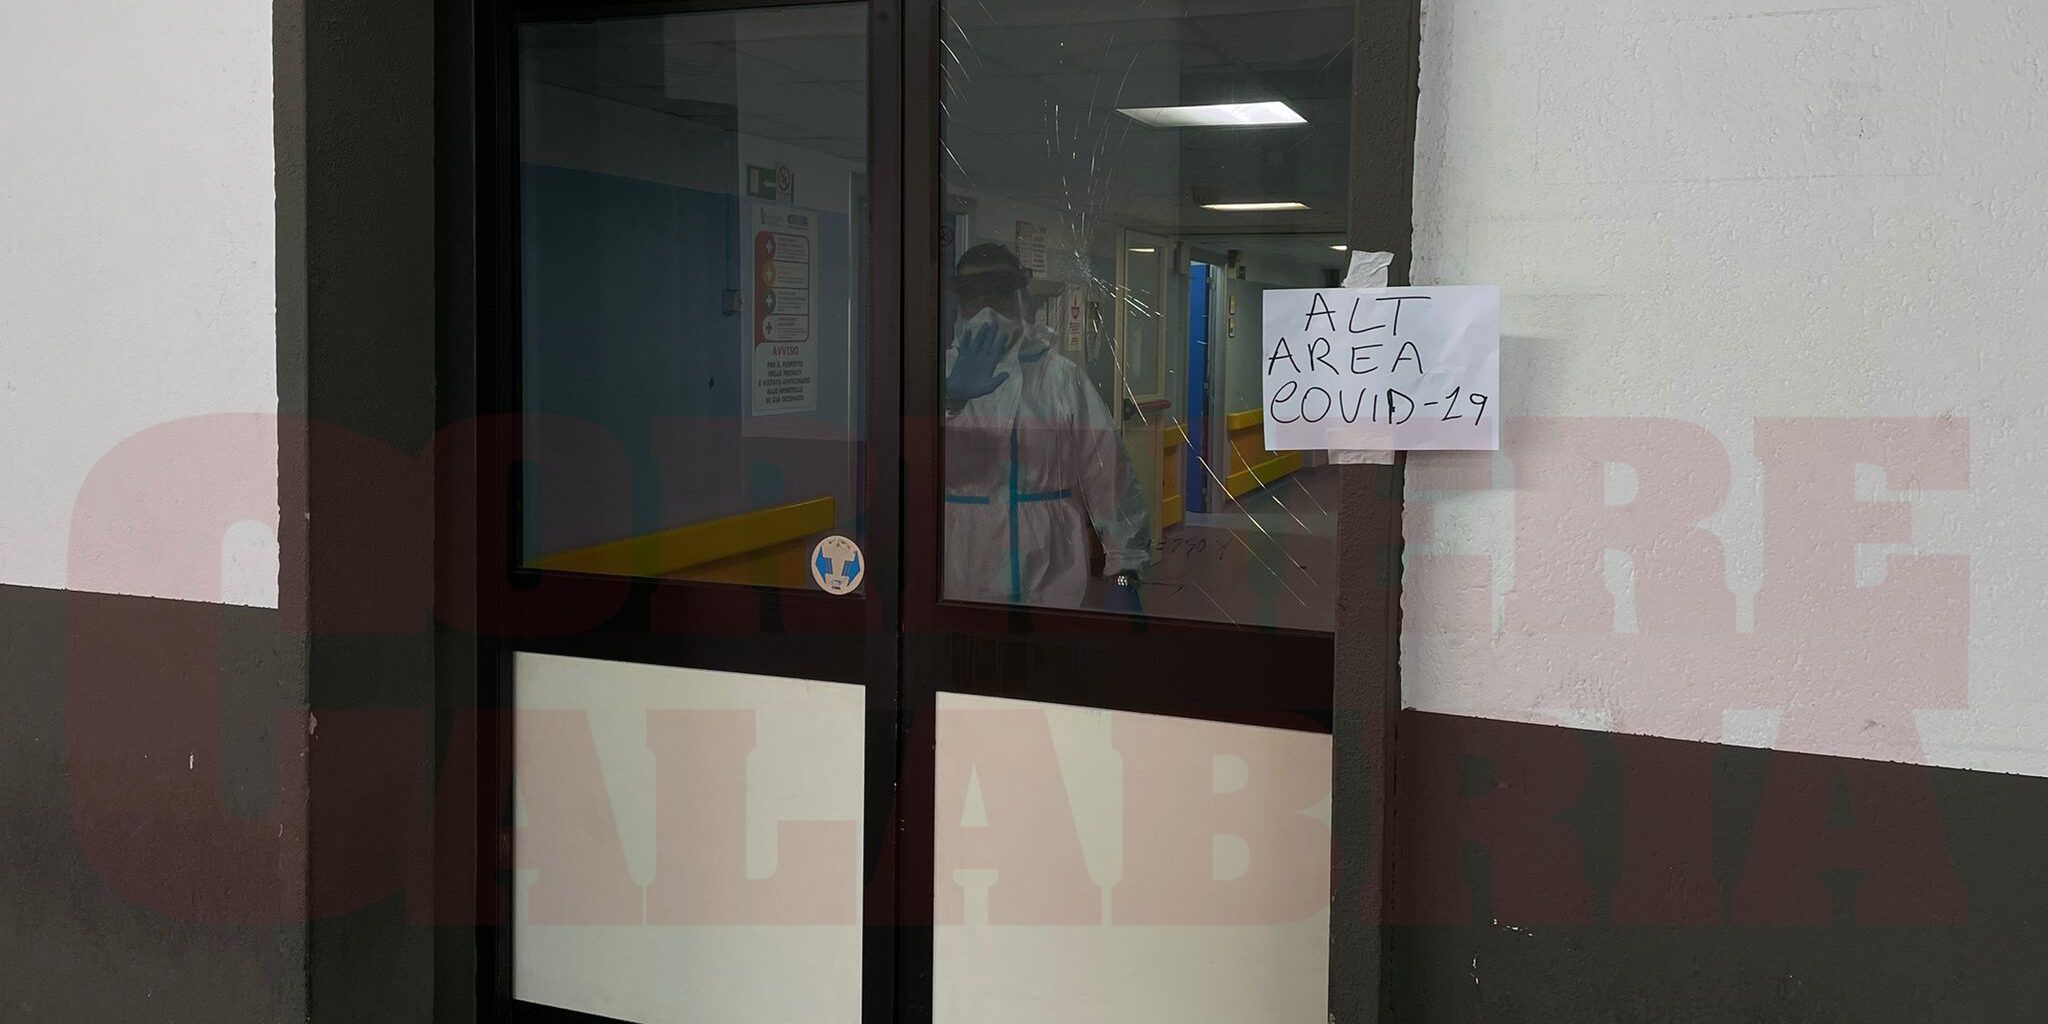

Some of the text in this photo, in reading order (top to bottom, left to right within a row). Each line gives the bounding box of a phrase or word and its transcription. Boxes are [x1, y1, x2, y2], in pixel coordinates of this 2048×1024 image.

[1304, 292, 1432, 337] ALT
[772, 346, 799, 357] AVVISO
[1268, 336, 1424, 376] AREA
[1270, 380, 1489, 426] COVID-19
